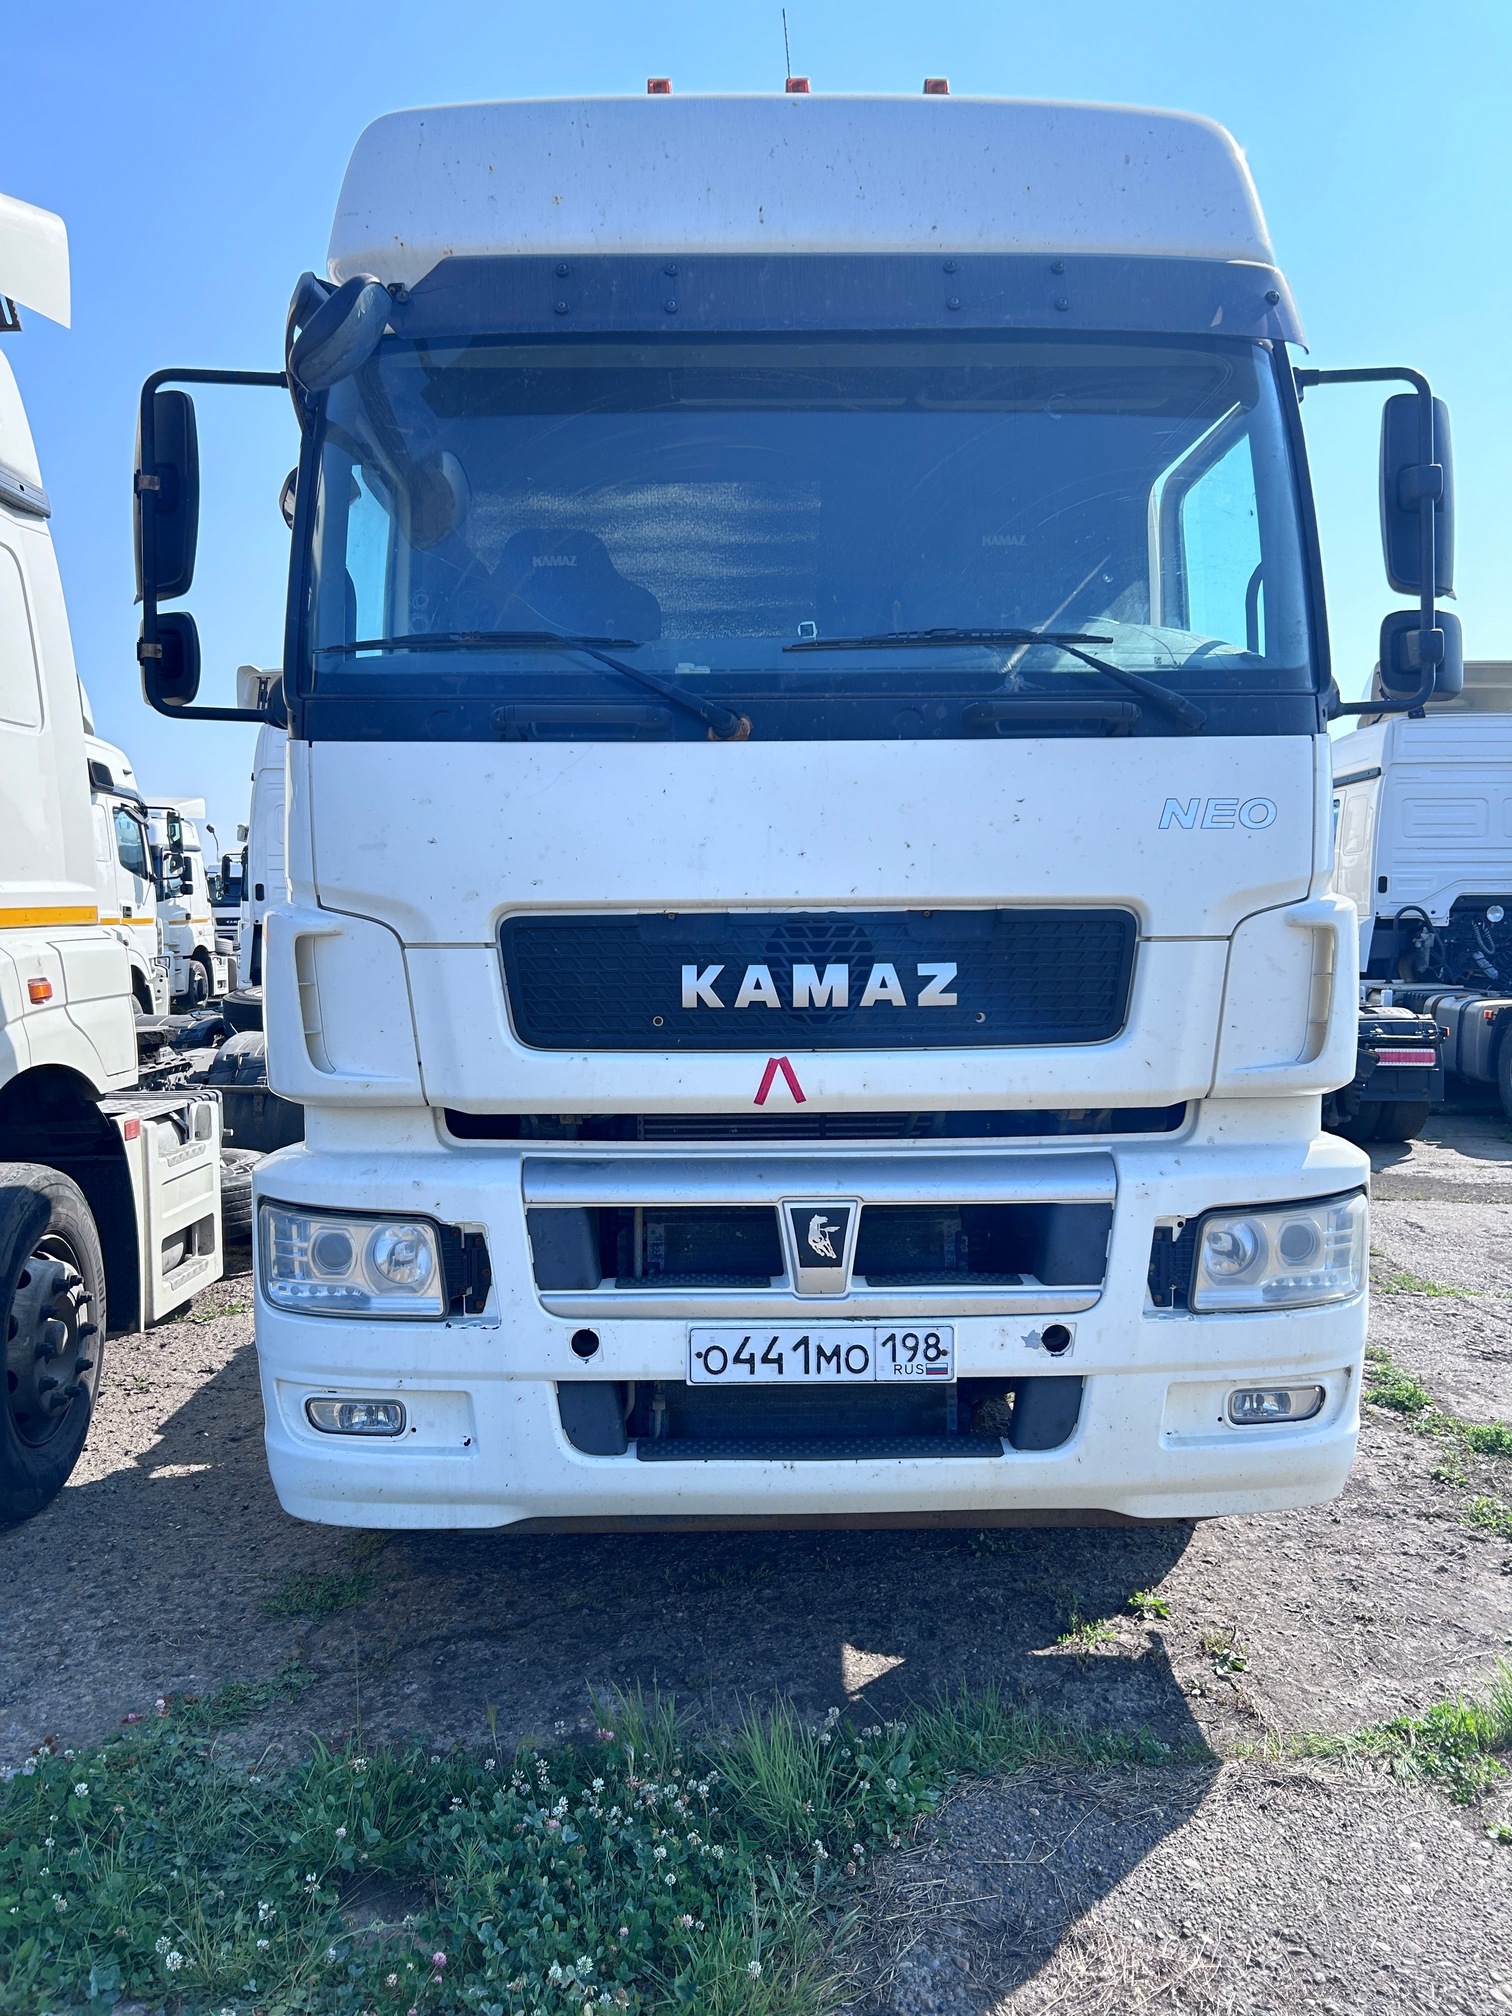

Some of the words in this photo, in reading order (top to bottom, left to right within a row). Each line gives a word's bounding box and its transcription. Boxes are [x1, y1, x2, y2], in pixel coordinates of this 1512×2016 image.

[981, 535, 1026, 546] KAMAZ
[532, 555, 578, 567] KAMAZ
[1158, 797, 1278, 830] NEO
[681, 962, 958, 1008] KAMAZ
[881, 1332, 941, 1363] 198
[893, 1363, 924, 1375] RUS
